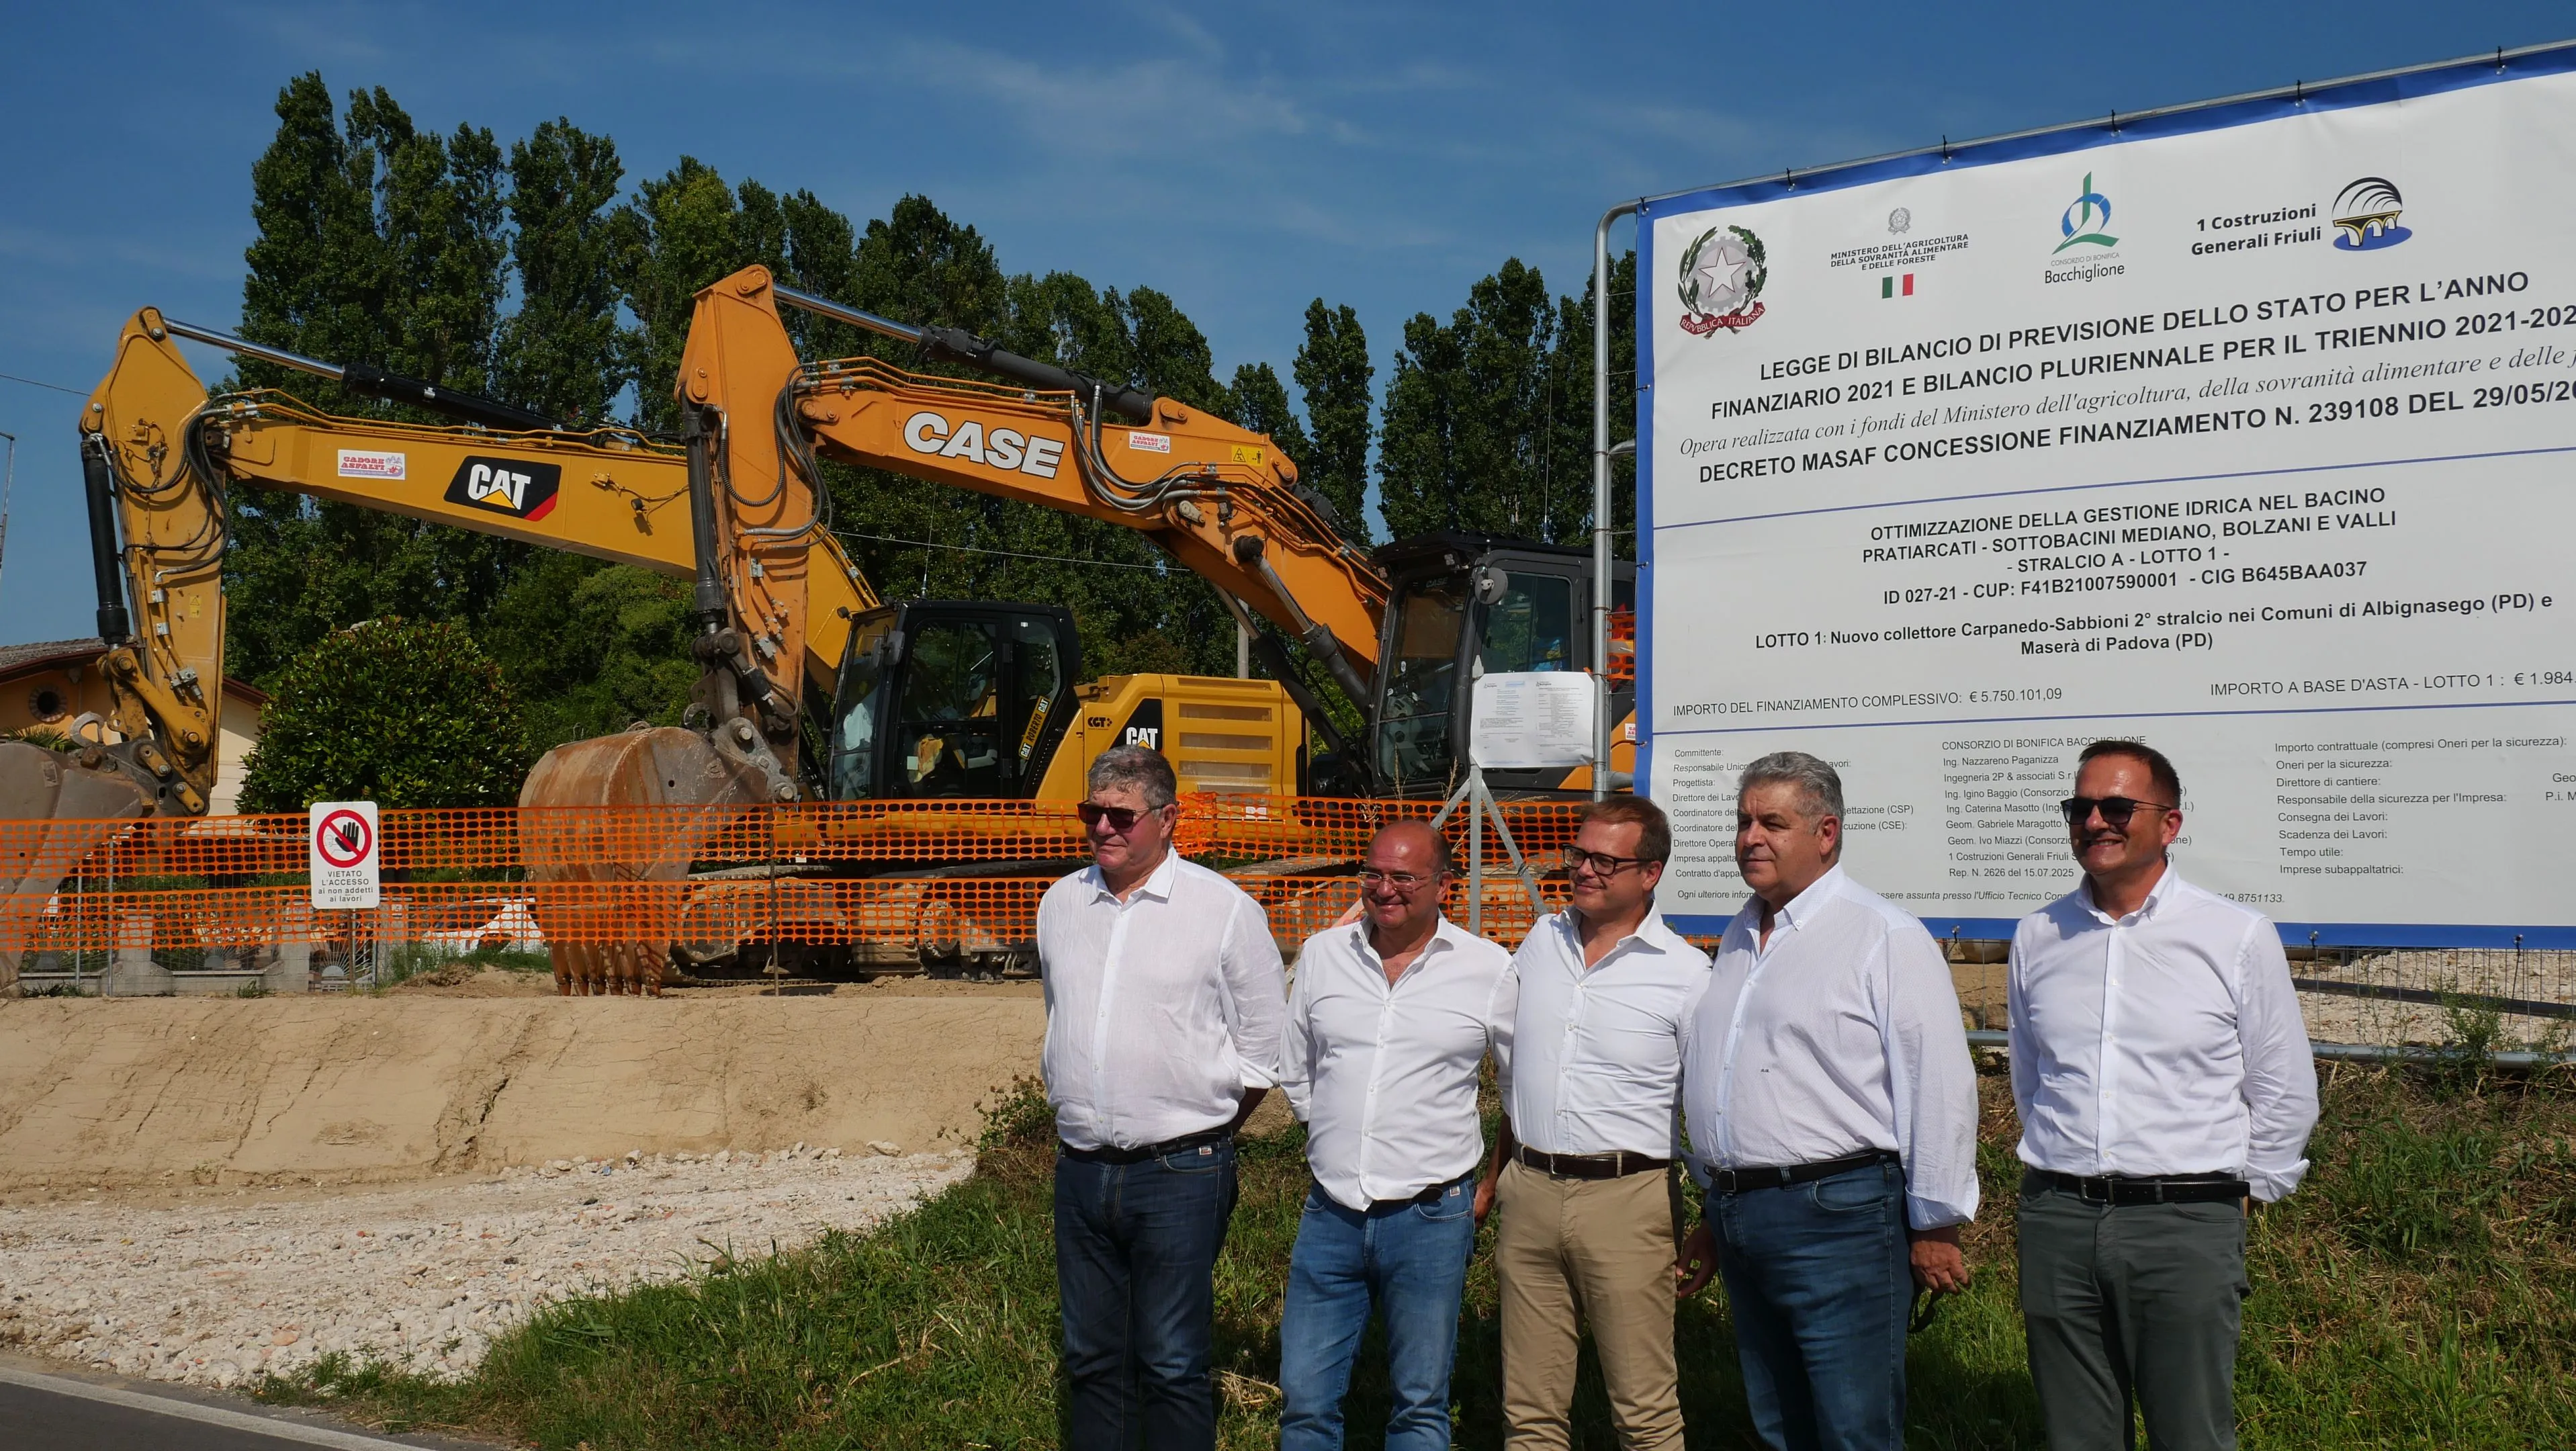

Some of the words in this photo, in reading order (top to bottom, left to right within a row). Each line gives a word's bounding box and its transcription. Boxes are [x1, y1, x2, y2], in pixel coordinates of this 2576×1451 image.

[2196, 218, 2205, 232] 1
[2211, 203, 2316, 230] Costruzioni
[1830, 247, 1879, 260] MINISTERO
[1881, 234, 1969, 252] DELL'AGRICOLTURA
[2191, 232, 2268, 256] Generali
[2274, 226, 2321, 246] Friuli
[1830, 259, 1856, 268] DELLA
[1858, 249, 1909, 264] SOVRANITÀ
[1911, 241, 1969, 257] ALIMENTARE
[1869, 261, 1895, 270] DELLE
[1897, 254, 1936, 266] FORESTE
[2050, 257, 2085, 267] CONSORZIO
[2093, 252, 2120, 261] BONIFICA
[2045, 263, 2125, 283] Bacchiglione
[1728, 307, 1765, 326] ITALIANA
[1761, 354, 1830, 381] LEGGE
[1838, 351, 1858, 370] DI
[1865, 337, 1972, 367] BILANCIO
[1980, 333, 2000, 353] DI
[2009, 314, 2155, 349] PREVISIONE
[2163, 304, 2248, 331] DELLO
[2256, 292, 2346, 320] STATO
[2356, 285, 2411, 310] PER
[2420, 271, 2528, 302] L'ANNO
[1712, 386, 1840, 420] FINANZIARIO
[1847, 380, 1892, 402] 2021
[1902, 377, 1916, 396] E
[1924, 363, 2033, 393] BILANCIO
[2041, 343, 2215, 380] PLURIENNALE
[2223, 337, 2276, 361] PER
[2284, 334, 2307, 354] IL
[2314, 318, 2446, 351] TRIENNIO
[1680, 438, 1727, 458] Opera
[1732, 427, 1810, 449] realizzata
[1815, 425, 1845, 439] con
[1850, 419, 1857, 435] i
[1857, 412, 1906, 439] fondi
[1910, 408, 1939, 428] del
[1943, 404, 2030, 425] Ministero
[2036, 386, 2190, 414] dell'agricoltura,
[2199, 377, 2249, 398] della
[2255, 365, 2354, 393] sovranità
[2362, 359, 2481, 383] alimentare
[2489, 357, 2501, 370] e
[2508, 345, 2565, 368] delle
[903, 411, 1065, 479] CASE
[1700, 455, 1795, 483] DECRETO
[1802, 446, 1877, 472] MASAF
[1884, 428, 2051, 463] CONCESSIONE
[2059, 408, 2266, 445] FINANZIAMENTO
[2275, 406, 2299, 426] N.
[2308, 396, 2399, 423] 239108
[2409, 390, 2464, 414] DEL
[468, 464, 531, 511] CAT
[1871, 515, 2013, 541] OTTIMIZZAZIONE
[2018, 511, 2078, 529] DELLA
[2084, 502, 2180, 523] GESTIONE
[2186, 497, 2253, 516] IDRICA
[2259, 494, 2299, 511] NEL
[2305, 487, 2385, 508] BACINO
[1863, 540, 1976, 563] PRATIARCATI
[1992, 529, 2115, 553] SOTTOBACINI
[2122, 523, 2216, 543] MEDIANO,
[2223, 517, 2311, 537] BOLZANI
[2317, 515, 2330, 531] E
[2336, 511, 2396, 529] VALLI
[1884, 590, 1900, 605] ID
[1905, 586, 1955, 603] 027-21
[1973, 582, 2014, 599] CUP:
[2021, 572, 2176, 596] F41B21007590001
[2201, 568, 2235, 584] CIG
[2242, 561, 2367, 582] B645BAA037
[1756, 631, 1809, 649] LOTTO
[1814, 631, 1826, 645] 1:
[1830, 631, 1879, 644] Nuovo
[1883, 625, 1957, 641] collettore
[1961, 613, 2129, 639] Carpanedo-Sabbioni
[2157, 609, 2223, 626] stralcio
[2229, 607, 2255, 623] nei
[2261, 603, 2333, 621] Comuni
[2339, 602, 2356, 618] di
[2362, 599, 2485, 619] Albignasego
[2491, 592, 2534, 614] (PD)
[2541, 596, 2552, 607] e
[2021, 638, 2080, 655] Maserà
[2085, 637, 2100, 652] di
[2106, 635, 2170, 651] Padova
[2176, 632, 2213, 652] (PD)
[1673, 703, 1727, 717] IMPORTO
[1730, 701, 1754, 713] DEL
[1757, 697, 1859, 712] FINANZIAMENTO
[1861, 692, 1962, 707] COMPLESSIVO:
[1969, 691, 1978, 703] €
[1981, 687, 2062, 703] 5.750.101,09
[1026, 713, 1042, 742] ROBERTO
[1087, 716, 1106, 728] CGT
[1126, 727, 1158, 750] CAT
[2275, 743, 2314, 754] Importo
[2317, 740, 2379, 752] contrattuale
[2381, 740, 2434, 752] (compresi
[2437, 738, 2468, 748] Oneri
[2471, 740, 2489, 750] per
[2492, 738, 2503, 747] la
[2505, 736, 2567, 748] sicurezza):
[1674, 748, 1724, 758] Committente:
[1943, 758, 1959, 768] Ing.
[1961, 757, 2009, 766] Nazzareno
[2011, 755, 2059, 766] Paganizza
[1673, 778, 1716, 789] Progettista:
[2276, 777, 2321, 787] Direttore
[2323, 777, 2333, 787] di
[2336, 777, 2381, 787] cantiere:
[2277, 794, 2348, 807] Responsabile
[2350, 794, 2375, 804] della
[2378, 795, 2430, 803] sicurezza
[2432, 795, 2451, 805] per
[2453, 792, 2507, 804] l'Impresa:
[2279, 847, 2316, 859] Tempo
[2319, 847, 2344, 857] utile:
[1949, 868, 1969, 879] Rep.
[1971, 868, 1981, 877] N.
[1984, 868, 2006, 877] 2626
[2008, 868, 2021, 877] del
[2024, 868, 2074, 877] 15.07.2025
[2280, 865, 2322, 876] Imprese
[2324, 865, 2403, 876] subappaltatrici:
